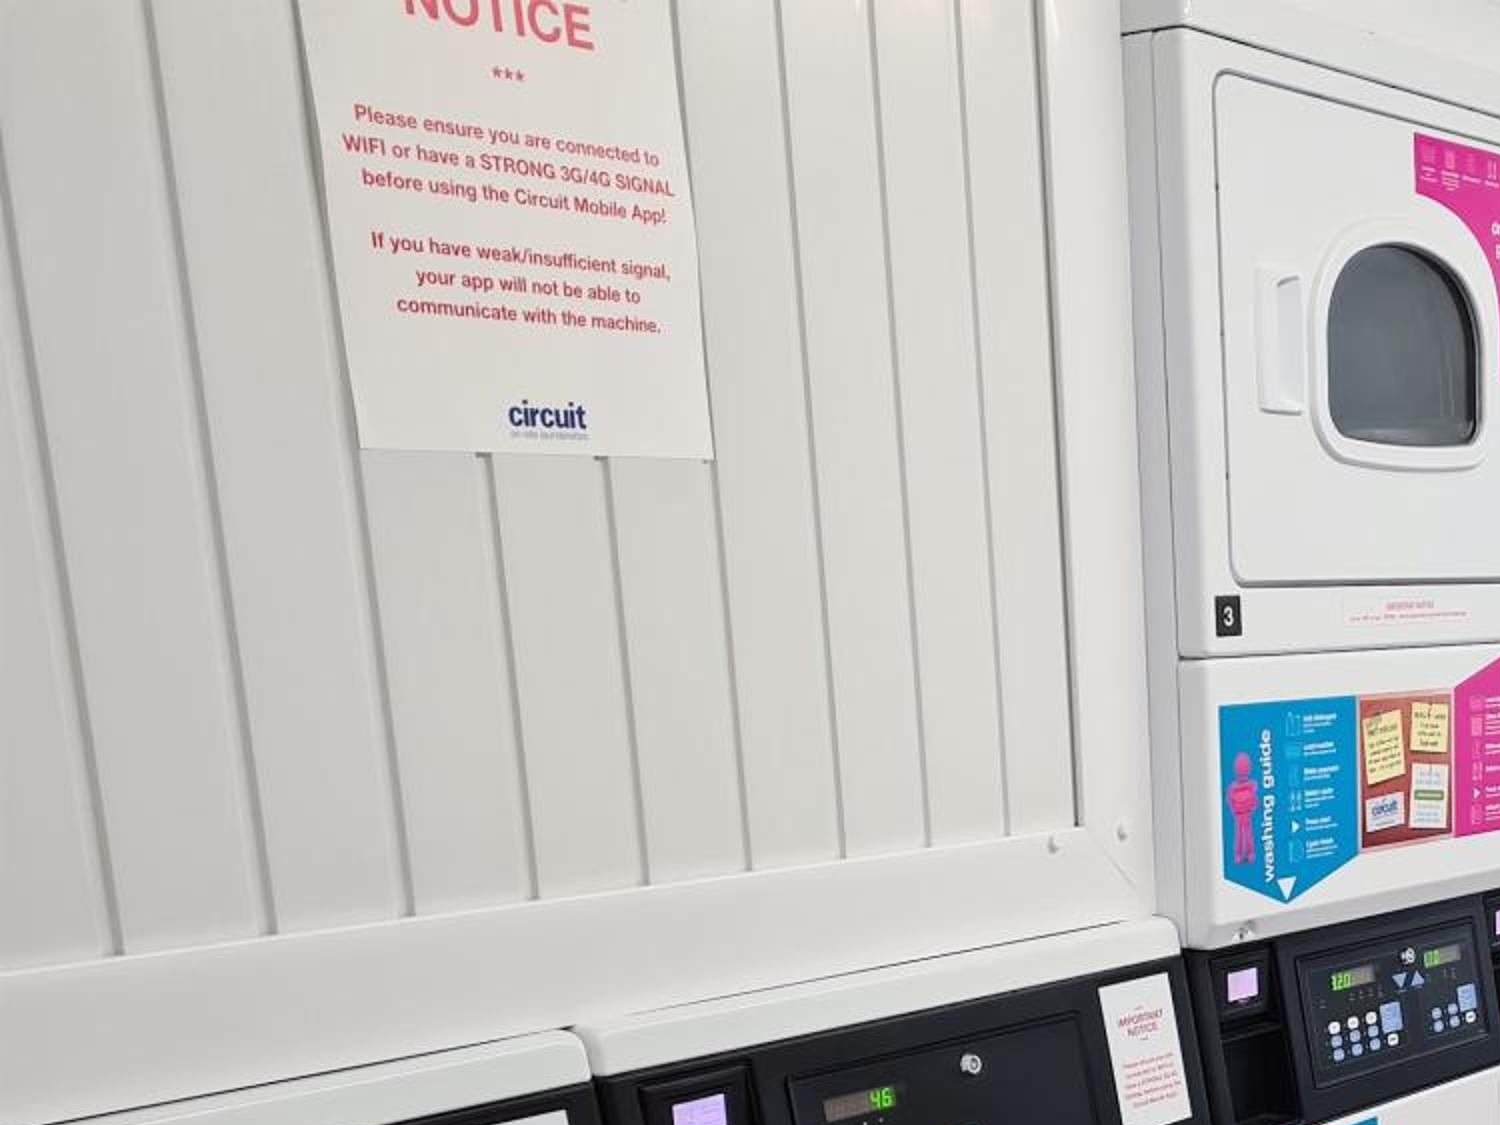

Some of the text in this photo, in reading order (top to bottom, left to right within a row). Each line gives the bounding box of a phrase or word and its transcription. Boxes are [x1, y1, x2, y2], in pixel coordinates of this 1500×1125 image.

[353, 103, 660, 167] Please ensure you are connected to
[341, 132, 676, 198] WIFI or have a STRONG 3G/4G SIGNAL
[361, 168, 667, 225] before using the Circuit Mobile App!
[370, 231, 671, 282] If you have weak/insufficient signal,
[415, 270, 641, 305] your app will not be able to
[396, 298, 661, 334] communicate with the machine.
[508, 399, 587, 429] circuit
[1223, 604, 1235, 627] 3
[1259, 729, 1276, 883] washing guide
[870, 1087, 893, 1110] 46
